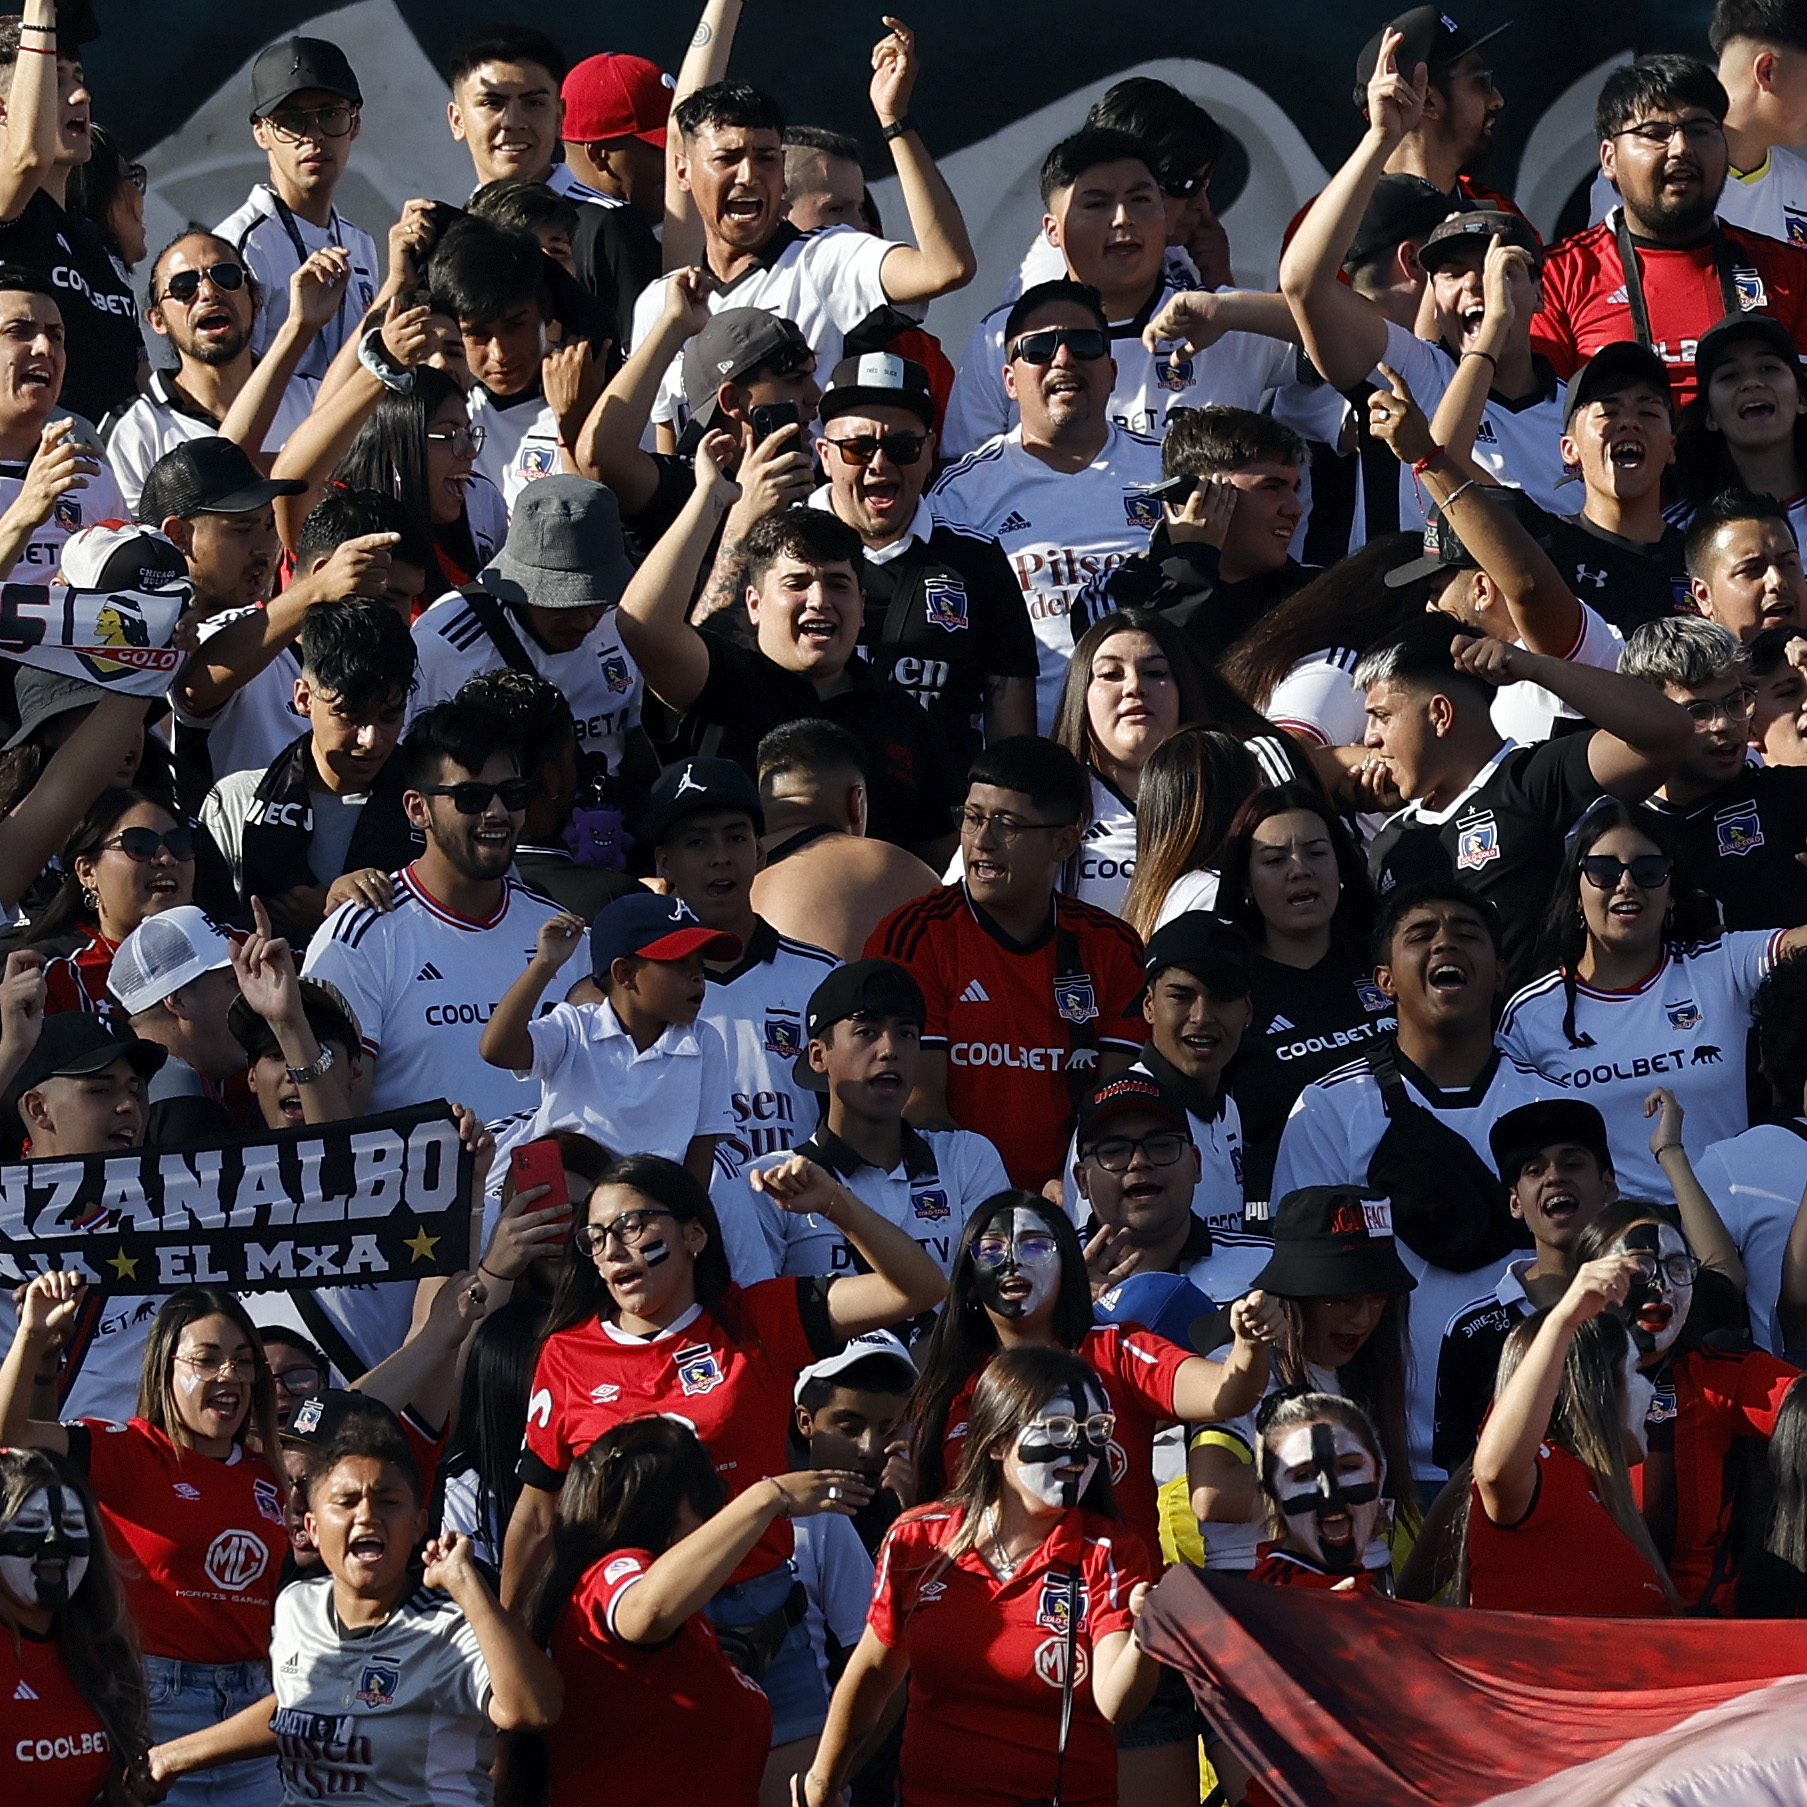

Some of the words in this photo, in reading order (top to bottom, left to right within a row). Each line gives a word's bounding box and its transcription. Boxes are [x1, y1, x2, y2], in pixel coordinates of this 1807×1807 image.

[140, 567, 176, 579] CHICAGO
[1721, 835, 1765, 855] COLO-COLO
[950, 1041, 1065, 1071] COOLBET
[1275, 1024, 1375, 1062] COOLBET
[1560, 1049, 1690, 1089] COOLBET
[154, 1246, 229, 1285] EL
[1494, 1317, 1511, 1332] GO
